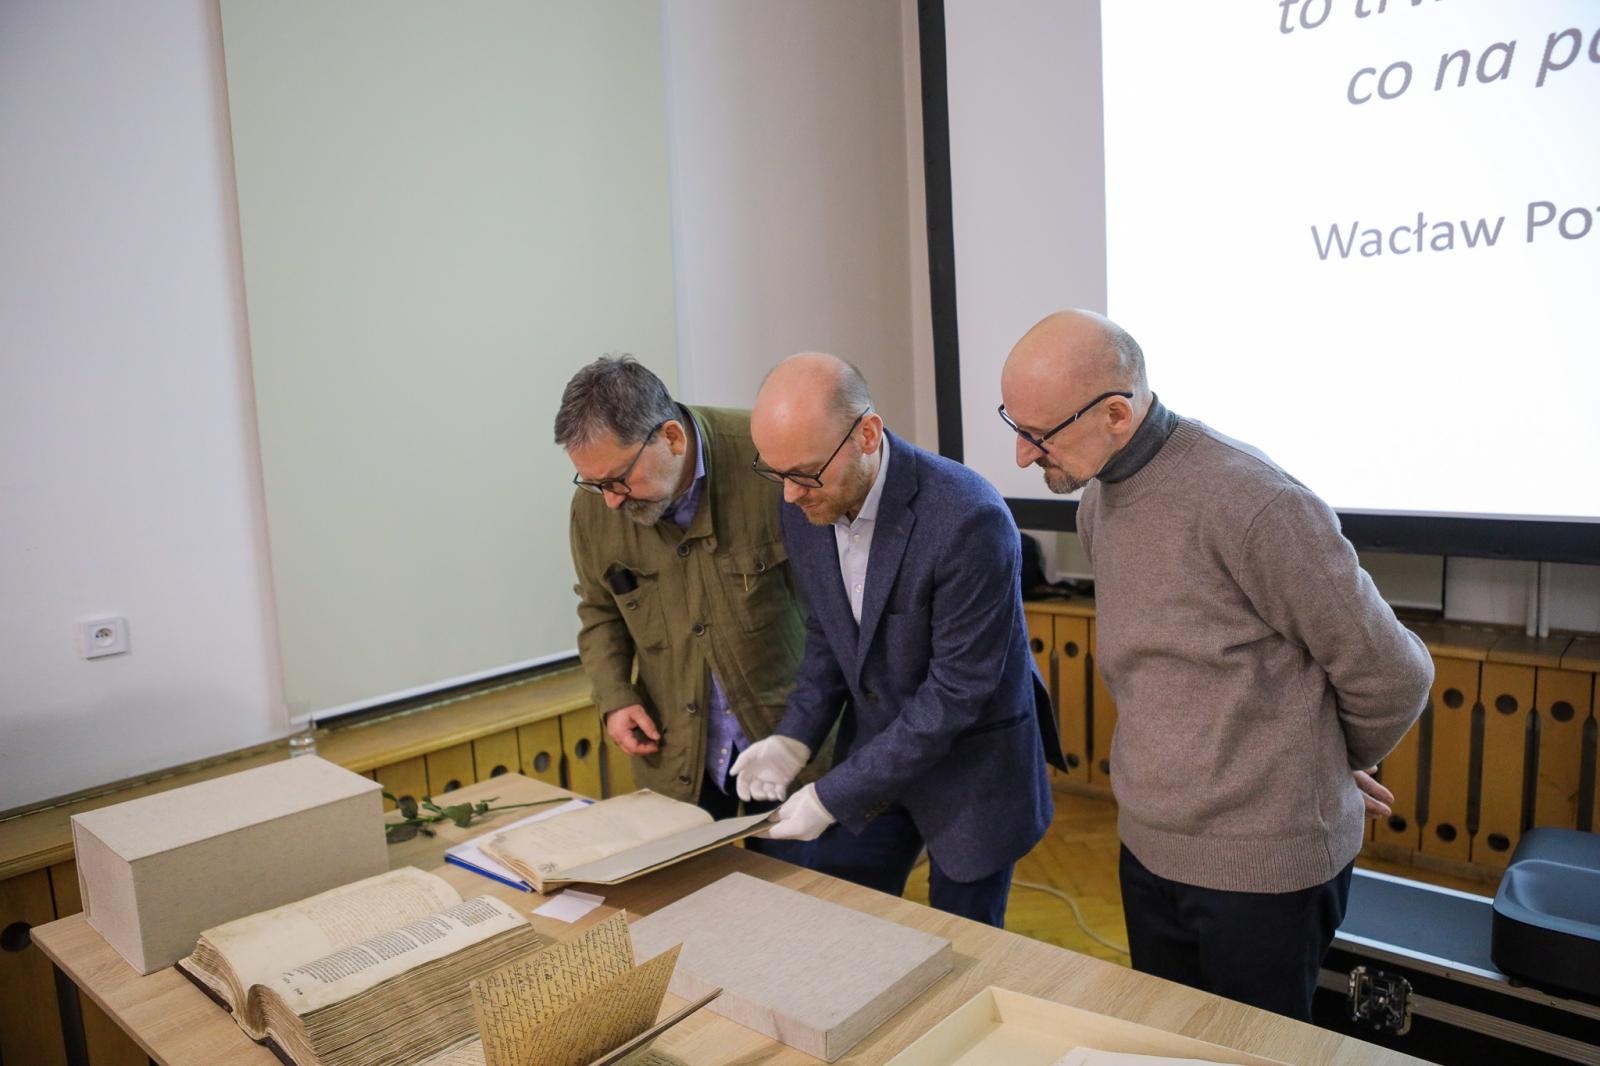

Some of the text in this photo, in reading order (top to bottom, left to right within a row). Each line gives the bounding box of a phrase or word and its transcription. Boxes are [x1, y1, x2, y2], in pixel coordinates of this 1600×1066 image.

[1278, 0, 1333, 35] to
[1346, 26, 1600, 105] co na p
[1310, 200, 1600, 261] Wacław Po
